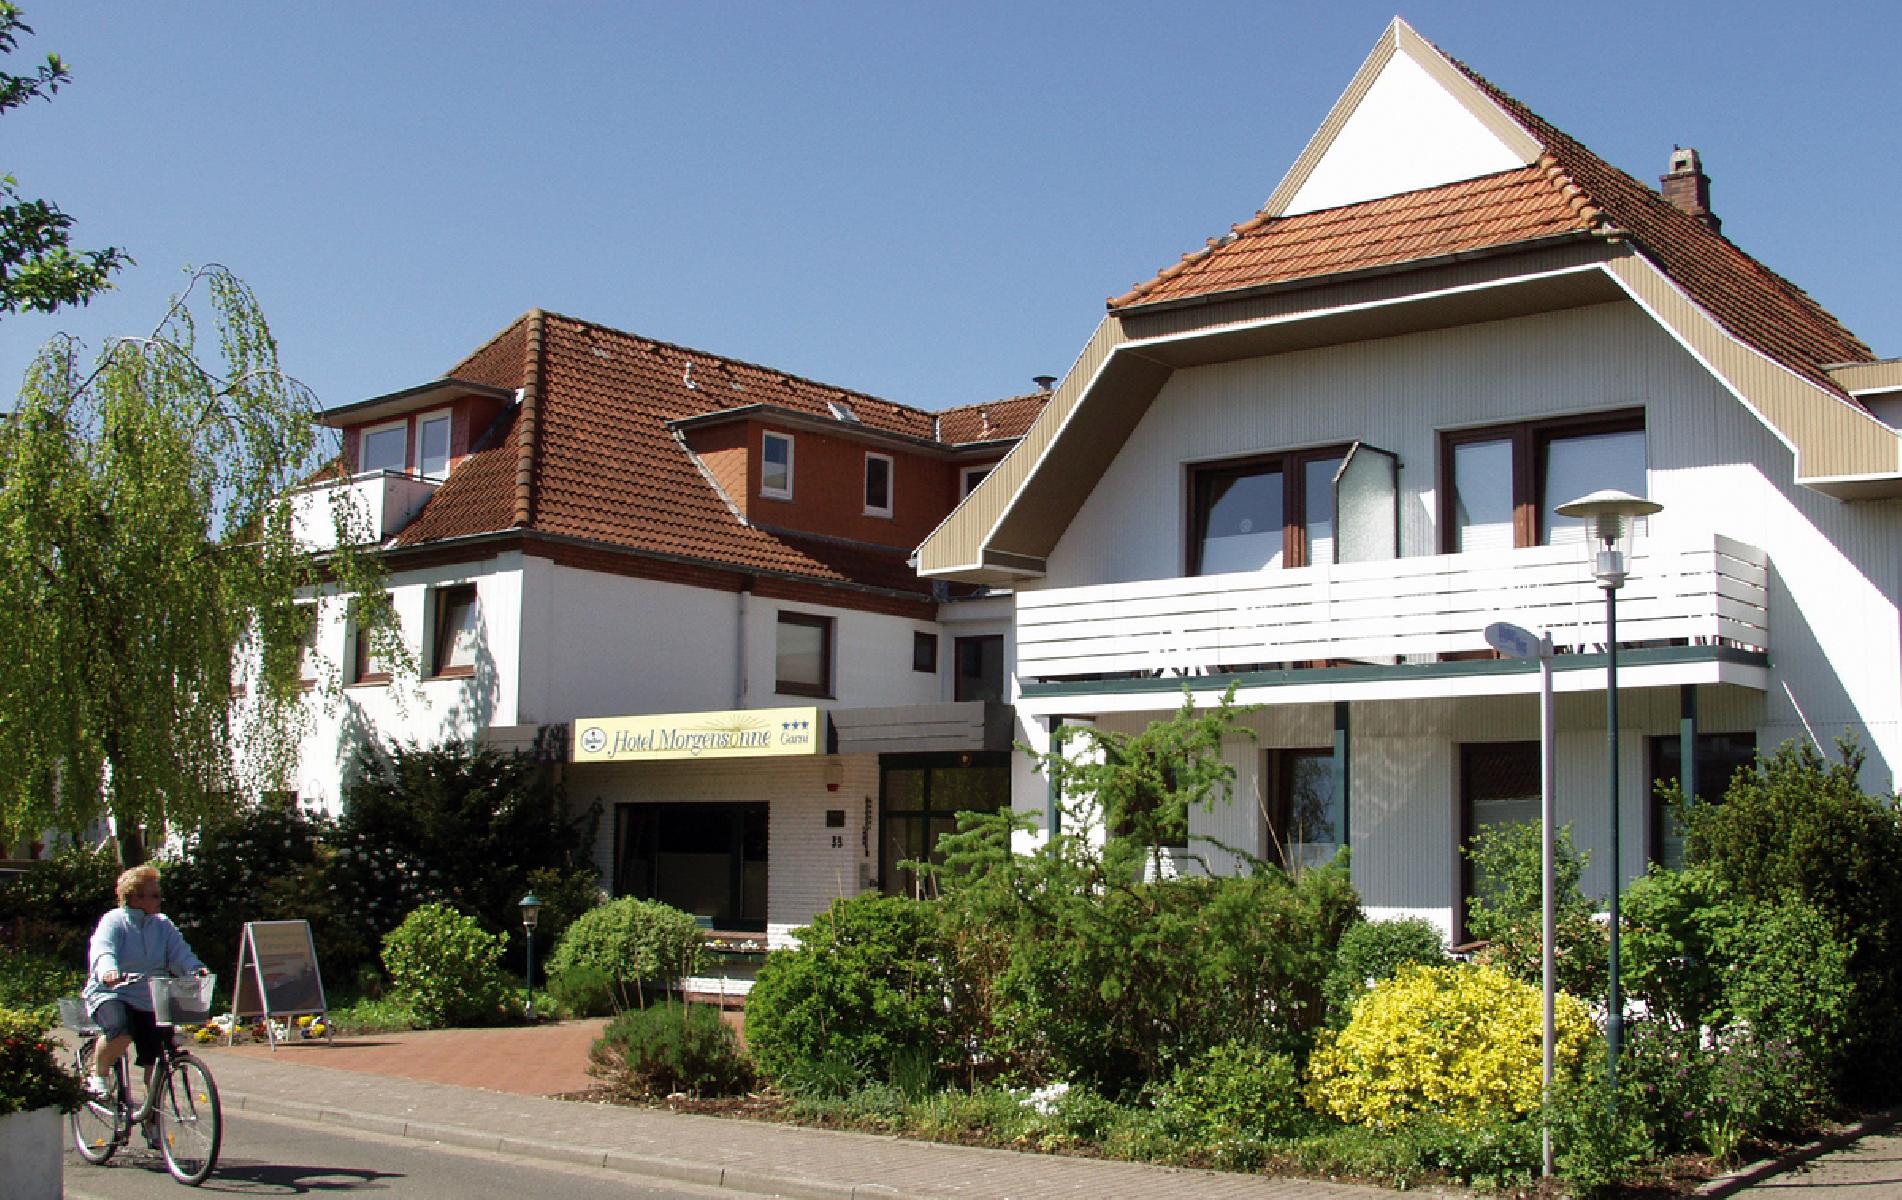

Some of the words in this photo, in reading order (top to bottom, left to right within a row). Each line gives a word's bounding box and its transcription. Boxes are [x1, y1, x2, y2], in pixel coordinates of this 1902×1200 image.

[608, 729, 655, 759] Hotel
[659, 729, 771, 756] Morgensonne
[780, 732, 809, 746] Garni
